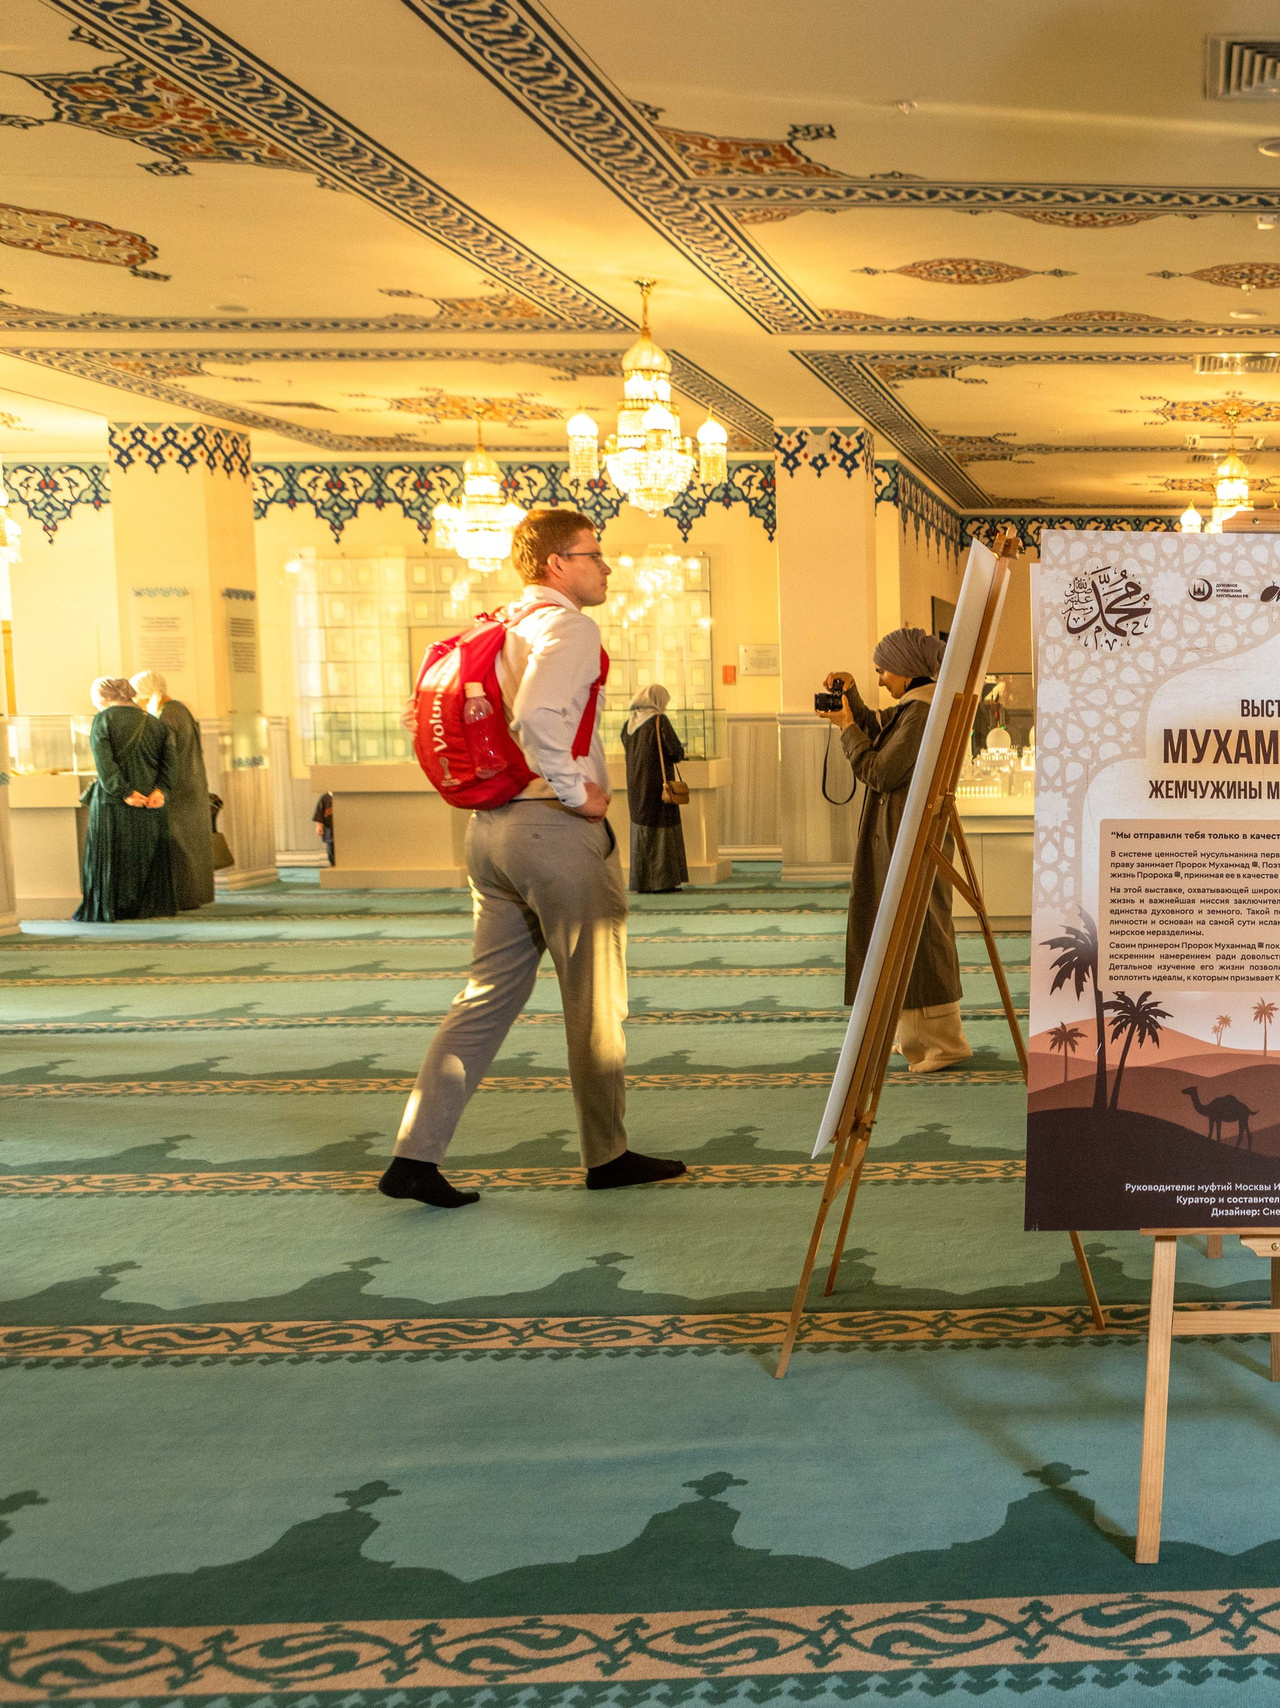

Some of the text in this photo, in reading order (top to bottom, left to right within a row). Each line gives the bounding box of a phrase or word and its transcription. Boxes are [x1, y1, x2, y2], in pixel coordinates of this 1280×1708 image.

[1148, 780, 1263, 800] ЖЕМЧУЖИНЫ
[1133, 832, 1182, 842] отправили
[1184, 830, 1205, 840] тебя
[1111, 849, 1116, 858] В
[1155, 849, 1197, 860] ценностей
[1200, 852, 1258, 860] мусульманина
[1111, 862, 1134, 870] праву
[1176, 860, 1207, 871] Пророк
[1209, 860, 1250, 871] Мухаммад
[1137, 870, 1173, 881] Пророка
[1184, 872, 1224, 881] принимая
[1110, 885, 1120, 894] На
[1124, 885, 1142, 894] этой
[1145, 887, 1184, 896] выставке,
[1187, 885, 1249, 896] охватывающей
[1149, 895, 1195, 904] важнейшая
[1110, 908, 1147, 917] единства
[1151, 908, 1194, 917] духовного
[1246, 906, 1270, 915] Такой
[1209, 917, 1234, 926] самой
[1237, 919, 1255, 928] сути
[1110, 929, 1204, 938] мирское неразделимы.
[1109, 940, 1136, 949] Своим
[1138, 942, 1180, 951] примером
[1182, 940, 1213, 951] Пророк
[1215, 940, 1256, 951] Мухаммад
[1109, 953, 1154, 962] искренним
[1160, 953, 1211, 962] намерением
[1216, 953, 1236, 962] ради
[1109, 961, 1152, 972] Детальное
[1157, 964, 1195, 972] изучение
[1152, 974, 1185, 983] идеалы,
[1193, 974, 1229, 983] которым
[1230, 974, 1274, 983] призывает
[1125, 1182, 1195, 1193] Руководители:
[1198, 1181, 1232, 1193] муфтий
[1235, 1181, 1271, 1191] Москвы
[1177, 1194, 1216, 1205] Куратор
[1211, 1206, 1260, 1218] Дизайнер:
